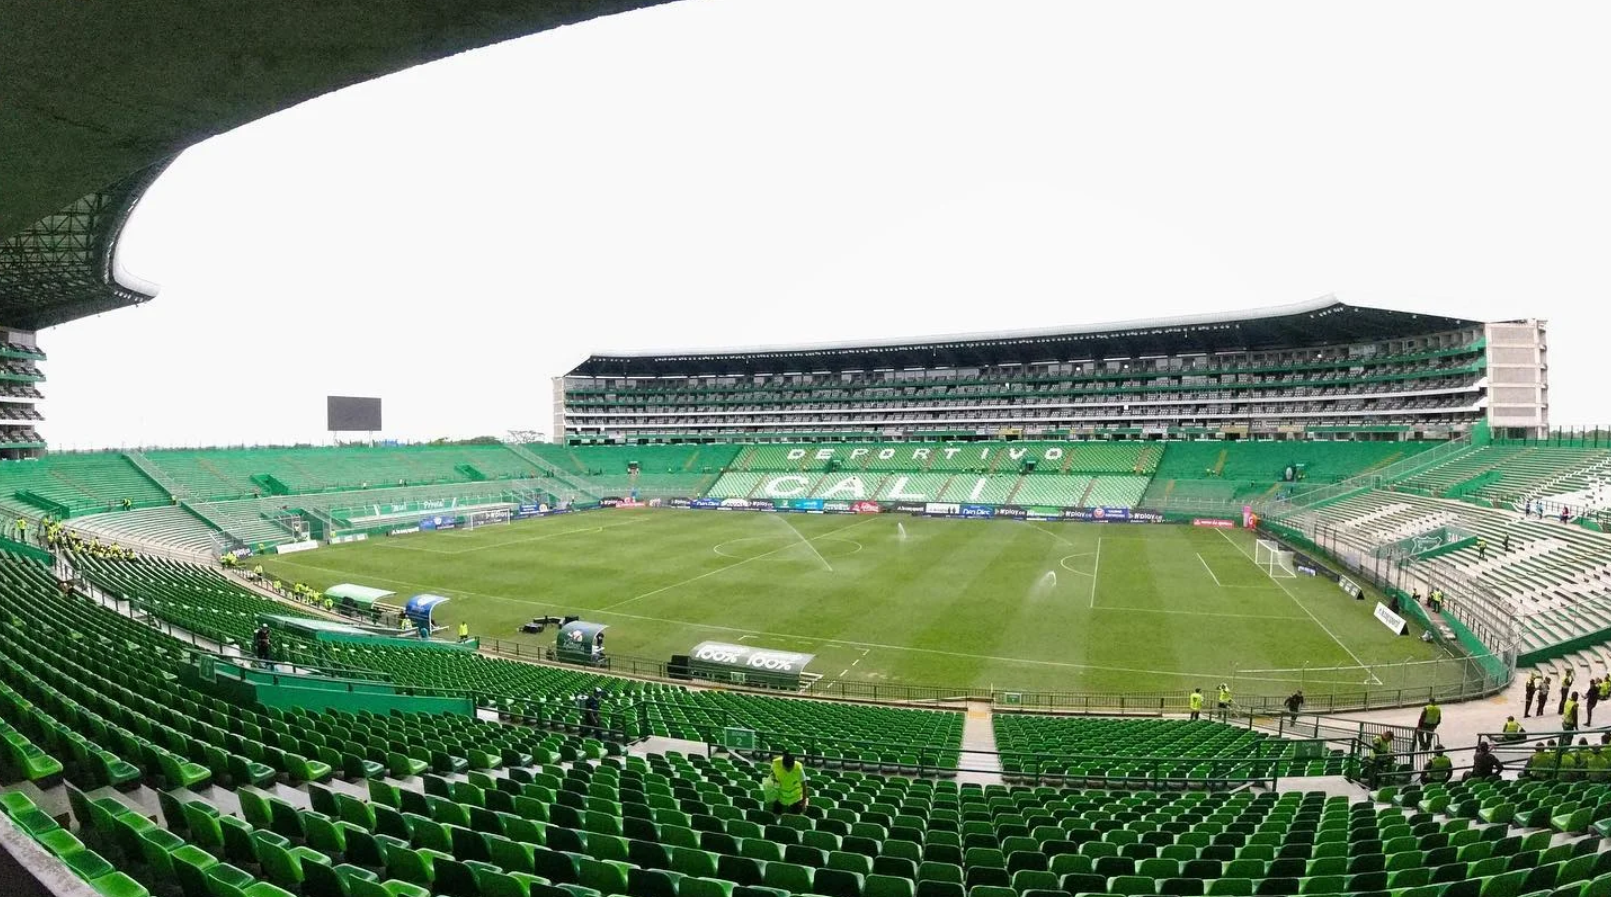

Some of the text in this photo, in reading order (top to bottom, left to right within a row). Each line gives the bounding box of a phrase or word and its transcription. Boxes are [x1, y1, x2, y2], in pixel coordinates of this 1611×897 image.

[787, 448, 1063, 460] DEPORTIVO
[765, 475, 987, 500] CALI
[695, 648, 739, 664] 100%
[746, 653, 794, 671] 100%
